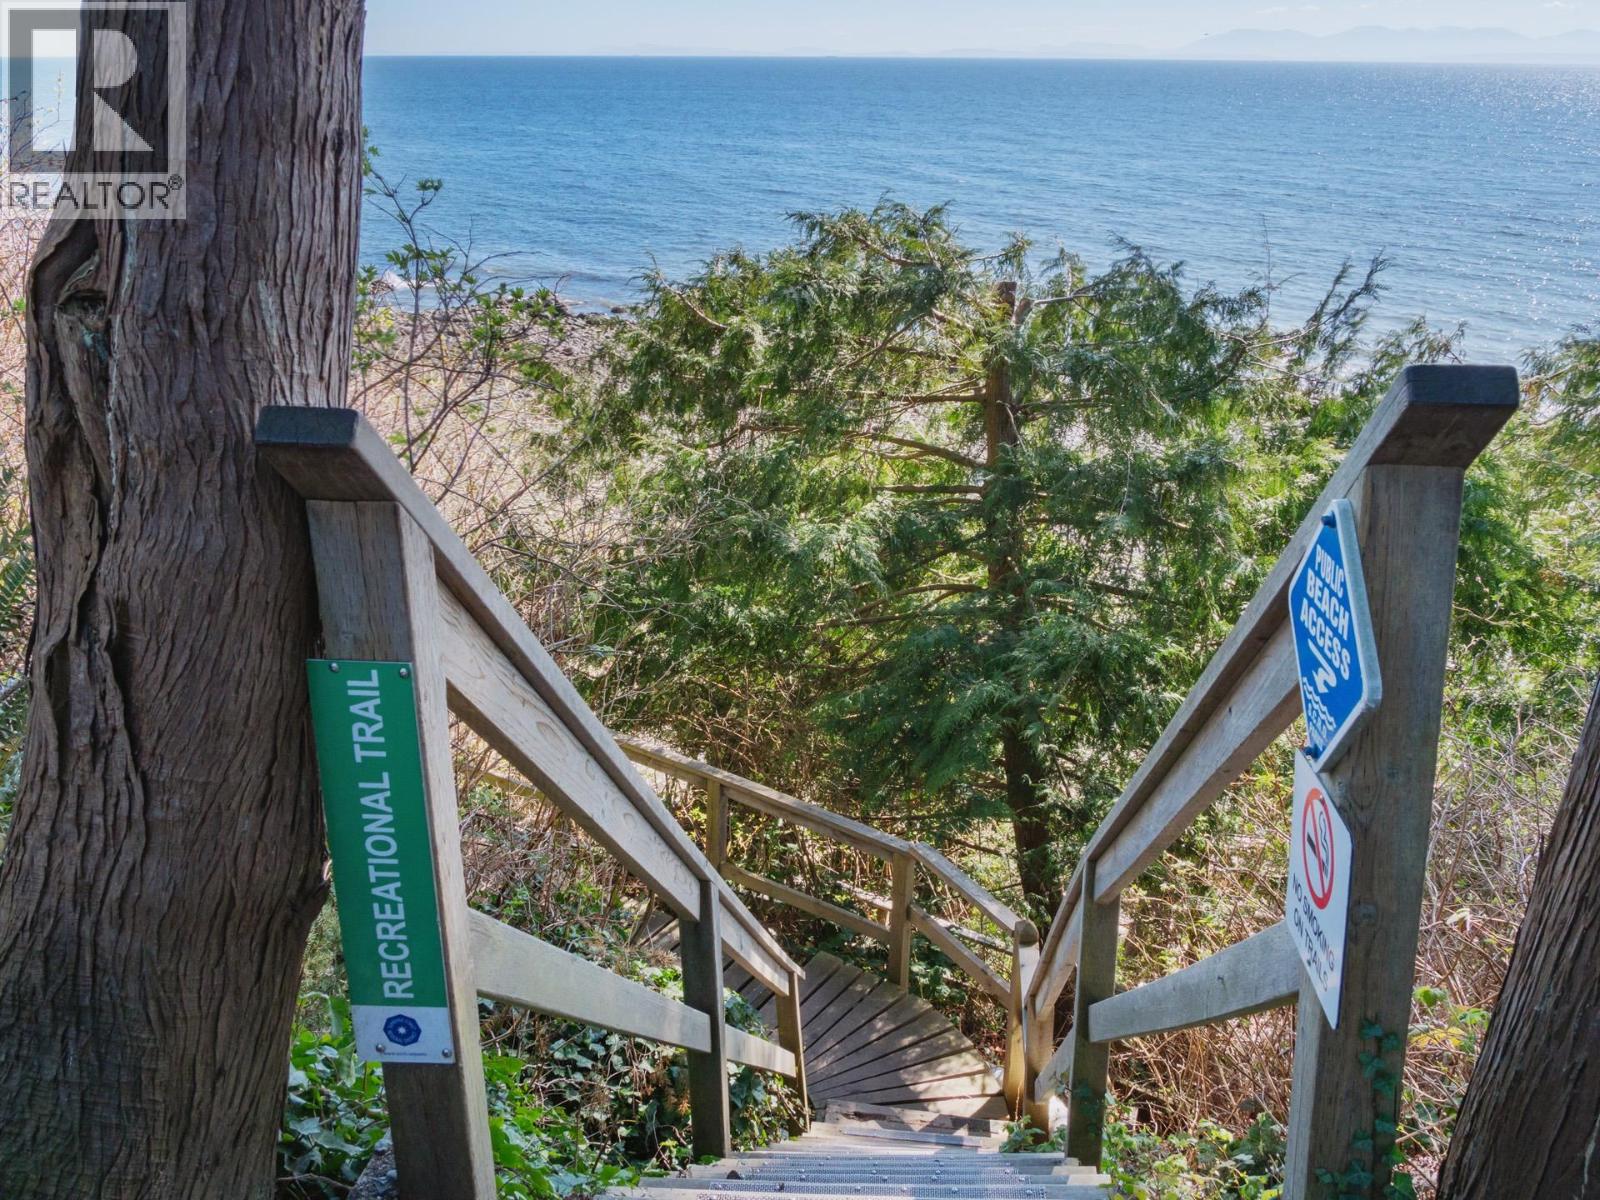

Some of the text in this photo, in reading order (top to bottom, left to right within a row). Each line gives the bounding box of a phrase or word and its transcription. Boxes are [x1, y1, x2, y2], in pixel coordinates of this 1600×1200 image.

[1306, 567, 1350, 641] BEACH
[1315, 543, 1345, 599] PUBLIC
[1300, 597, 1351, 681] ACCESS
[346, 669, 387, 764] TRAIL
[358, 771, 415, 999] RECREATIONAL
[1292, 872, 1336, 972] NO SMOKING
[1293, 907, 1329, 993] ON TRAILS
